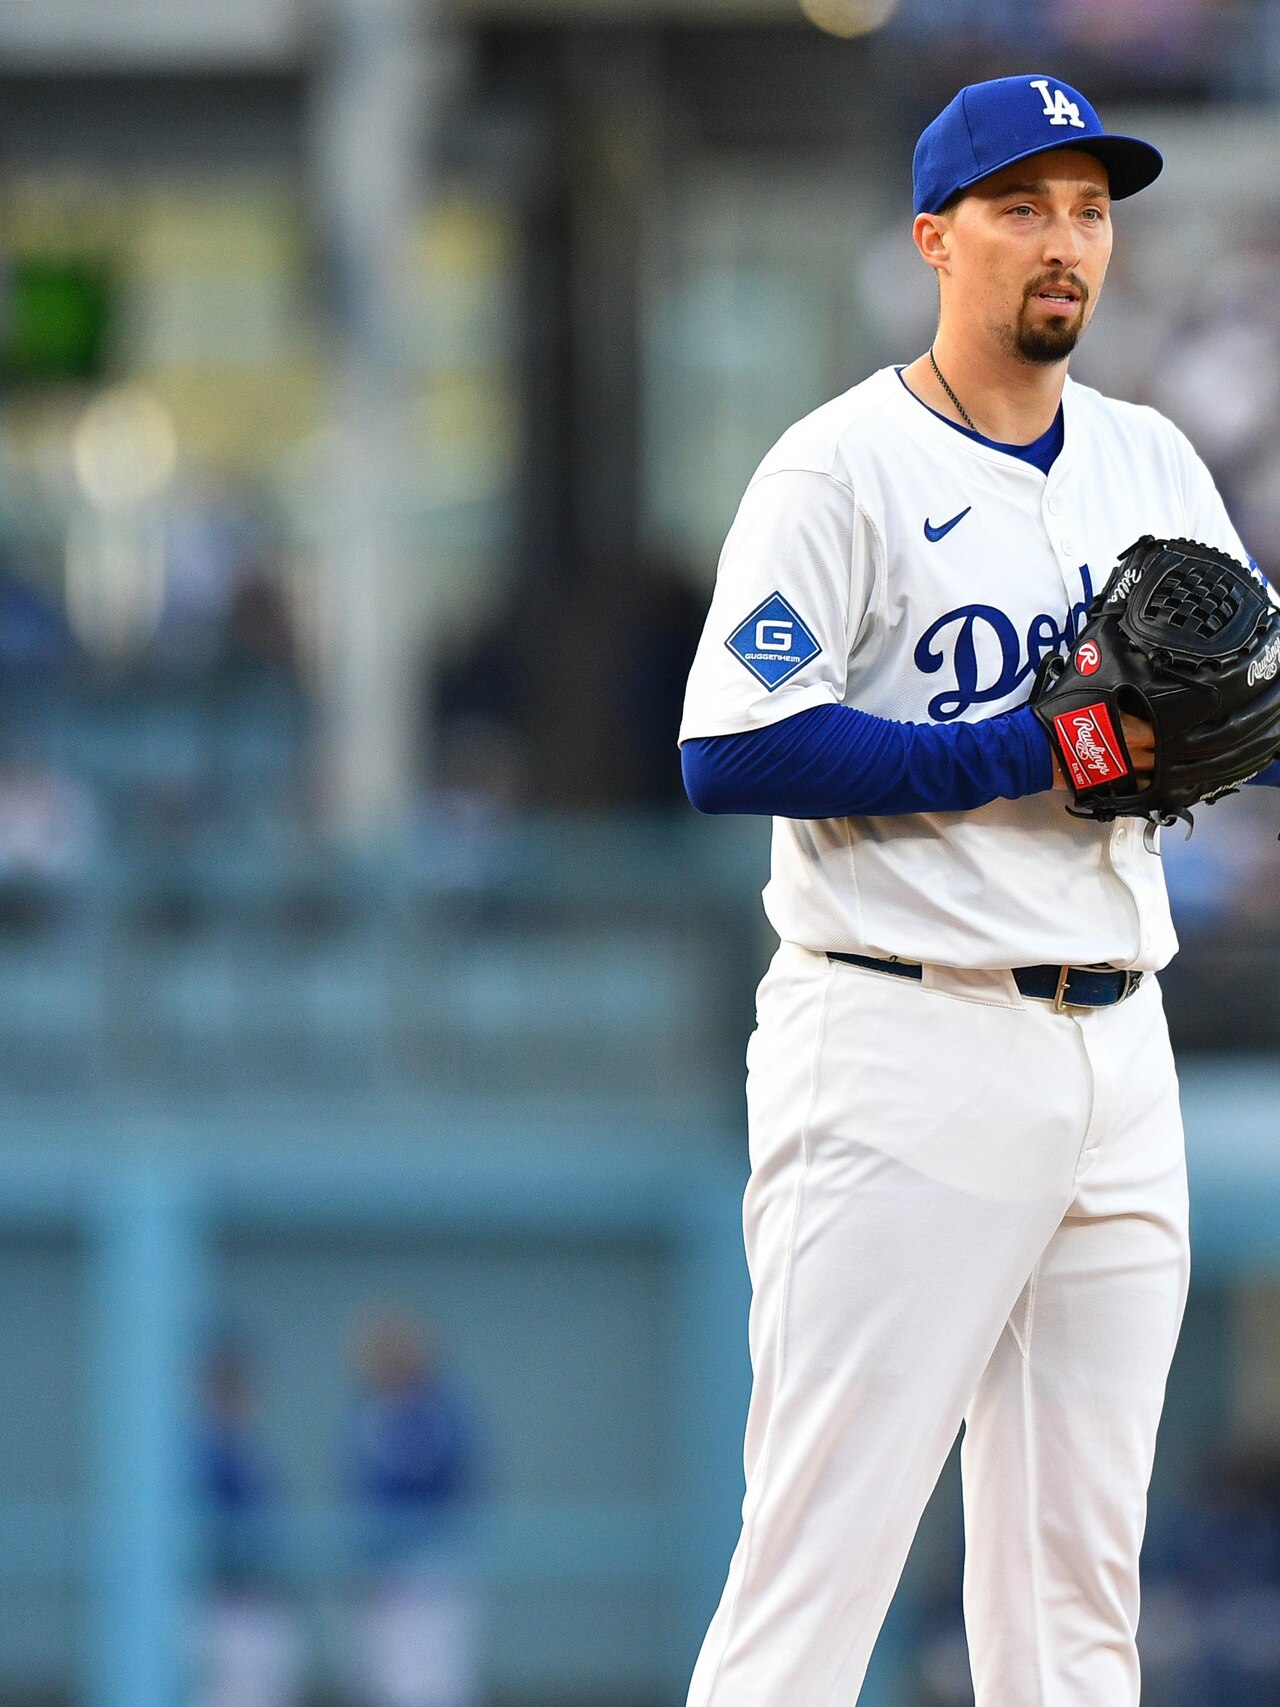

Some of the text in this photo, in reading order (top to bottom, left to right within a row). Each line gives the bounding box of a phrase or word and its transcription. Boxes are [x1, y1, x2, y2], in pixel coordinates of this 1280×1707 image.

[1030, 80, 1085, 128] LA
[756, 619, 793, 651] G
[744, 653, 800, 663] GUGGENHEIM
[1079, 643, 1098, 672] R
[1073, 717, 1110, 776] Rawlings
